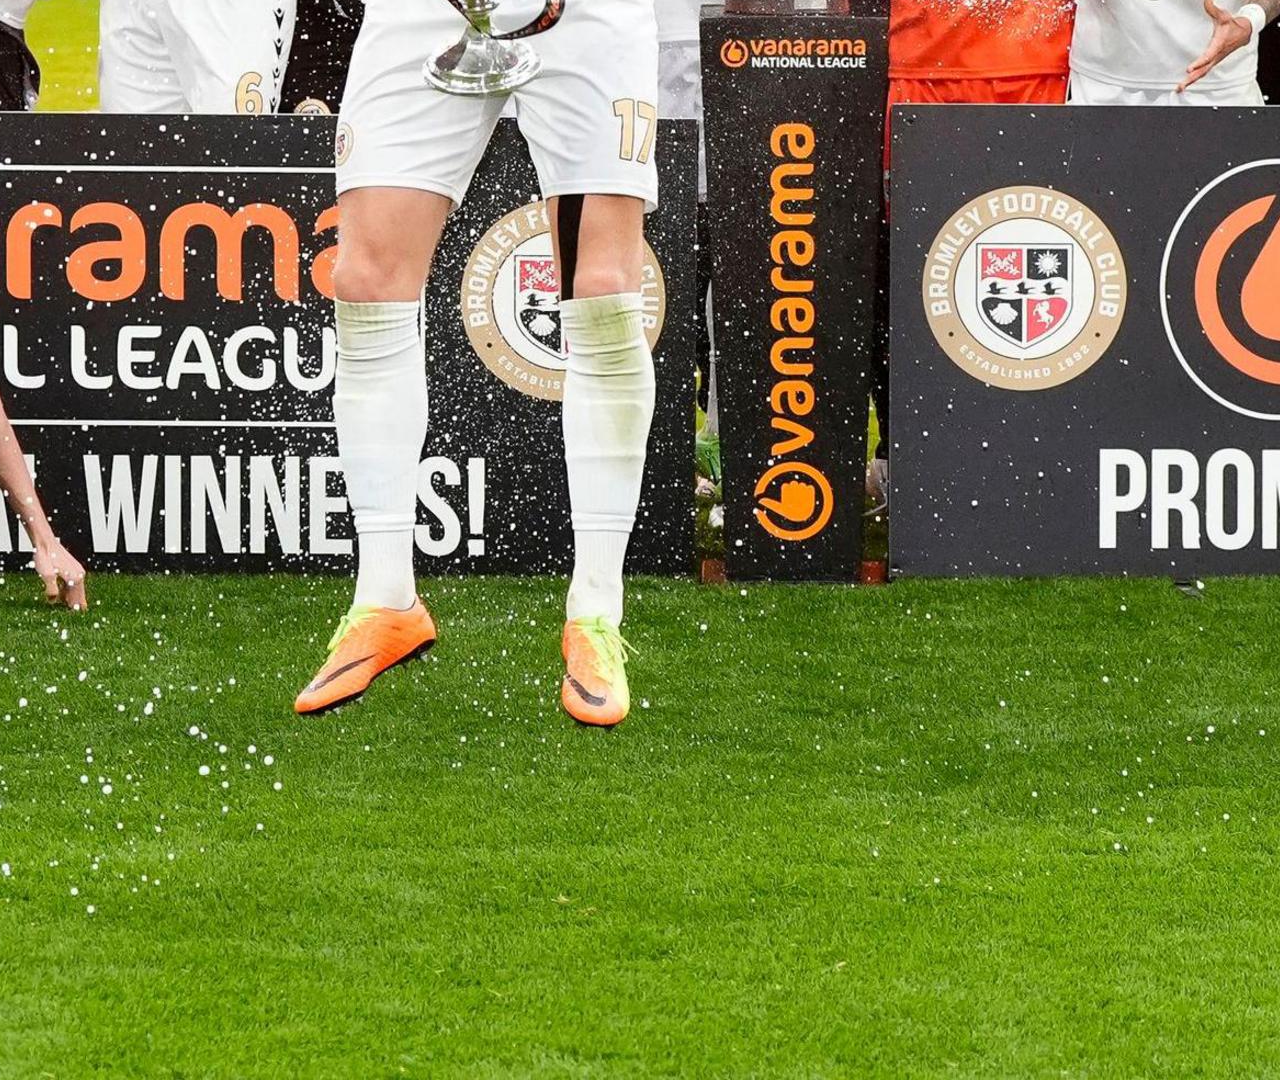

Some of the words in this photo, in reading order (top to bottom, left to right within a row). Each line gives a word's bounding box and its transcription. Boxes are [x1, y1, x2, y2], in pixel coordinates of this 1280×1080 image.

[750, 38, 867, 57] vanarama
[751, 57, 814, 69] NATIONAL
[817, 57, 867, 69] LEAGUE
[235, 71, 263, 113] 6
[612, 97, 657, 165] 17
[467, 216, 520, 329] BROMLEY
[928, 206, 985, 317] BROMLEY
[987, 192, 1106, 251] FOOTBALL
[1094, 252, 1121, 318] CLUB
[770, 121, 816, 457] vanarama
[70, 324, 338, 391] LEAGU
[496, 354, 562, 391] ESTABLIS
[958, 343, 1052, 381] ESTABLISHED
[1057, 343, 1091, 372] 1892
[83, 453, 486, 557] WINNES!
